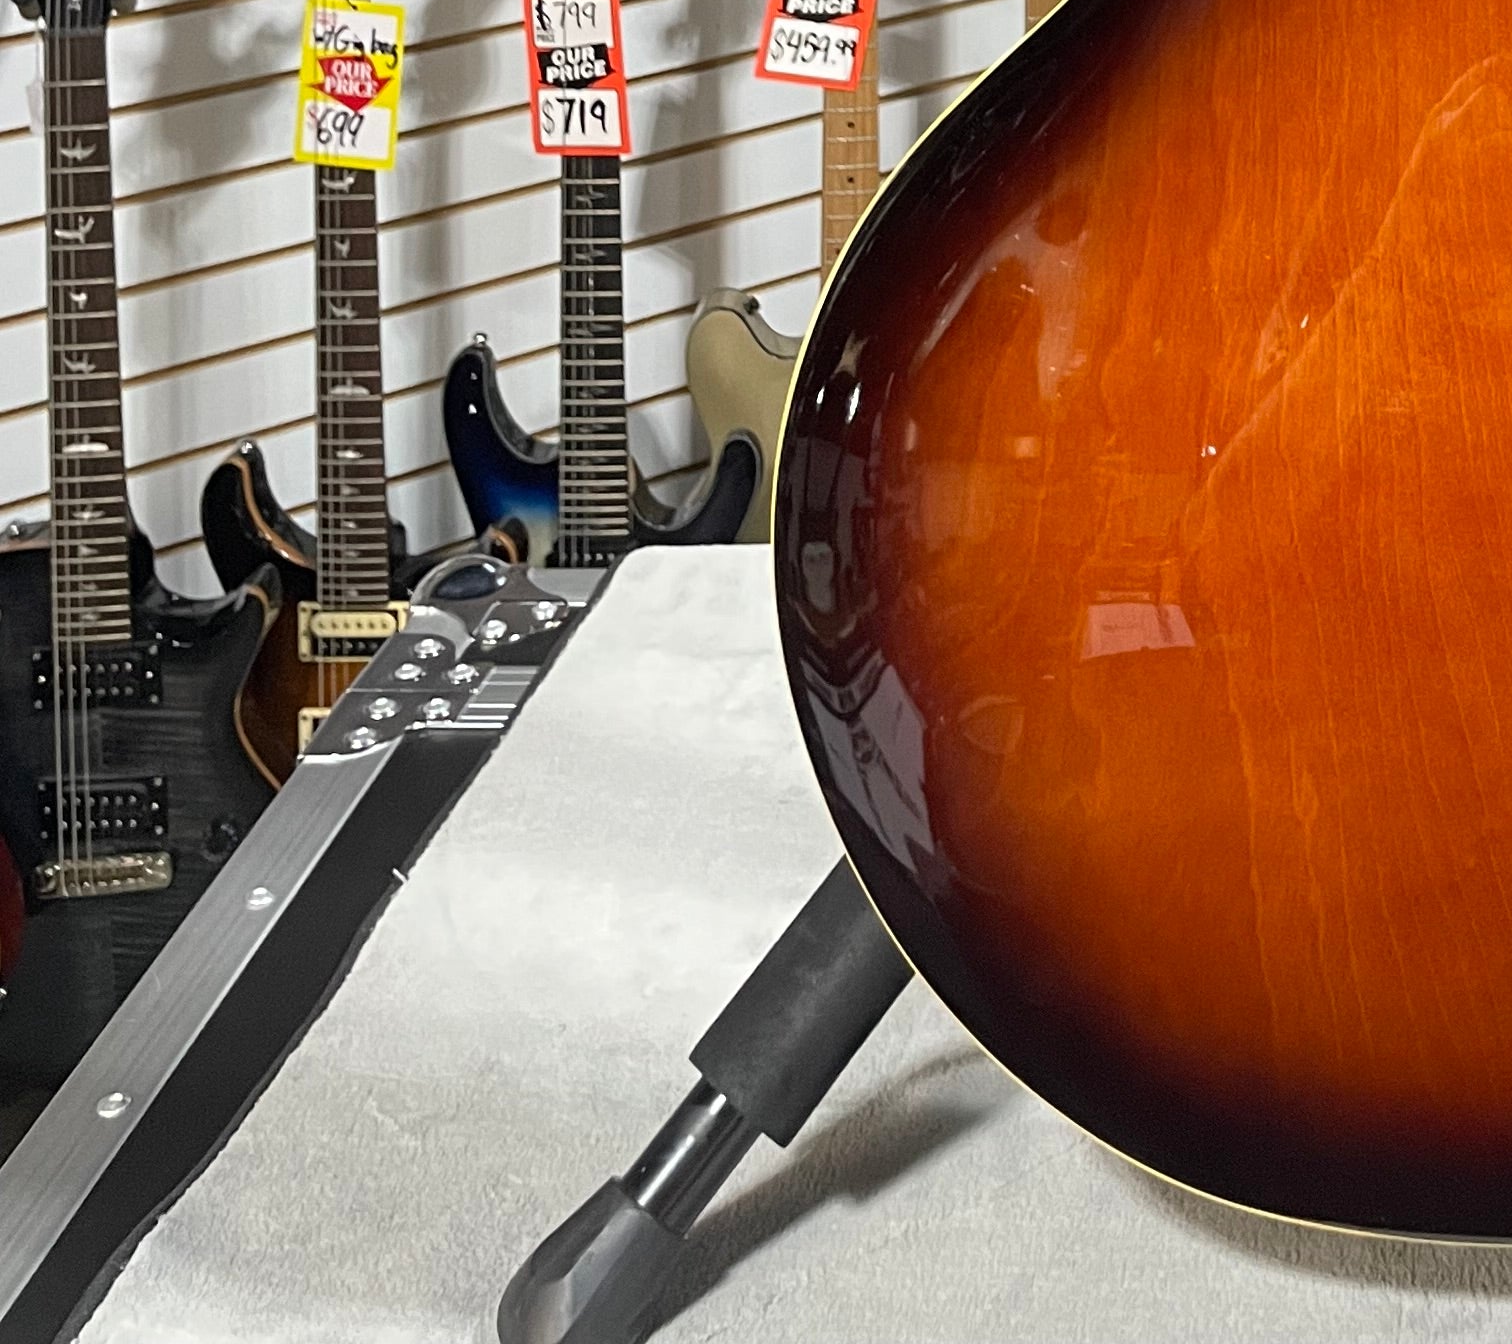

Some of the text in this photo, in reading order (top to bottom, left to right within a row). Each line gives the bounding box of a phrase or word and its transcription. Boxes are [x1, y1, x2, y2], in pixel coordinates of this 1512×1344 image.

[330, 58, 373, 80] OUR
[551, 47, 596, 67] OUR
[546, 59, 607, 84] PRICE
[324, 75, 379, 99] PRICE
[541, 97, 608, 135] $719
